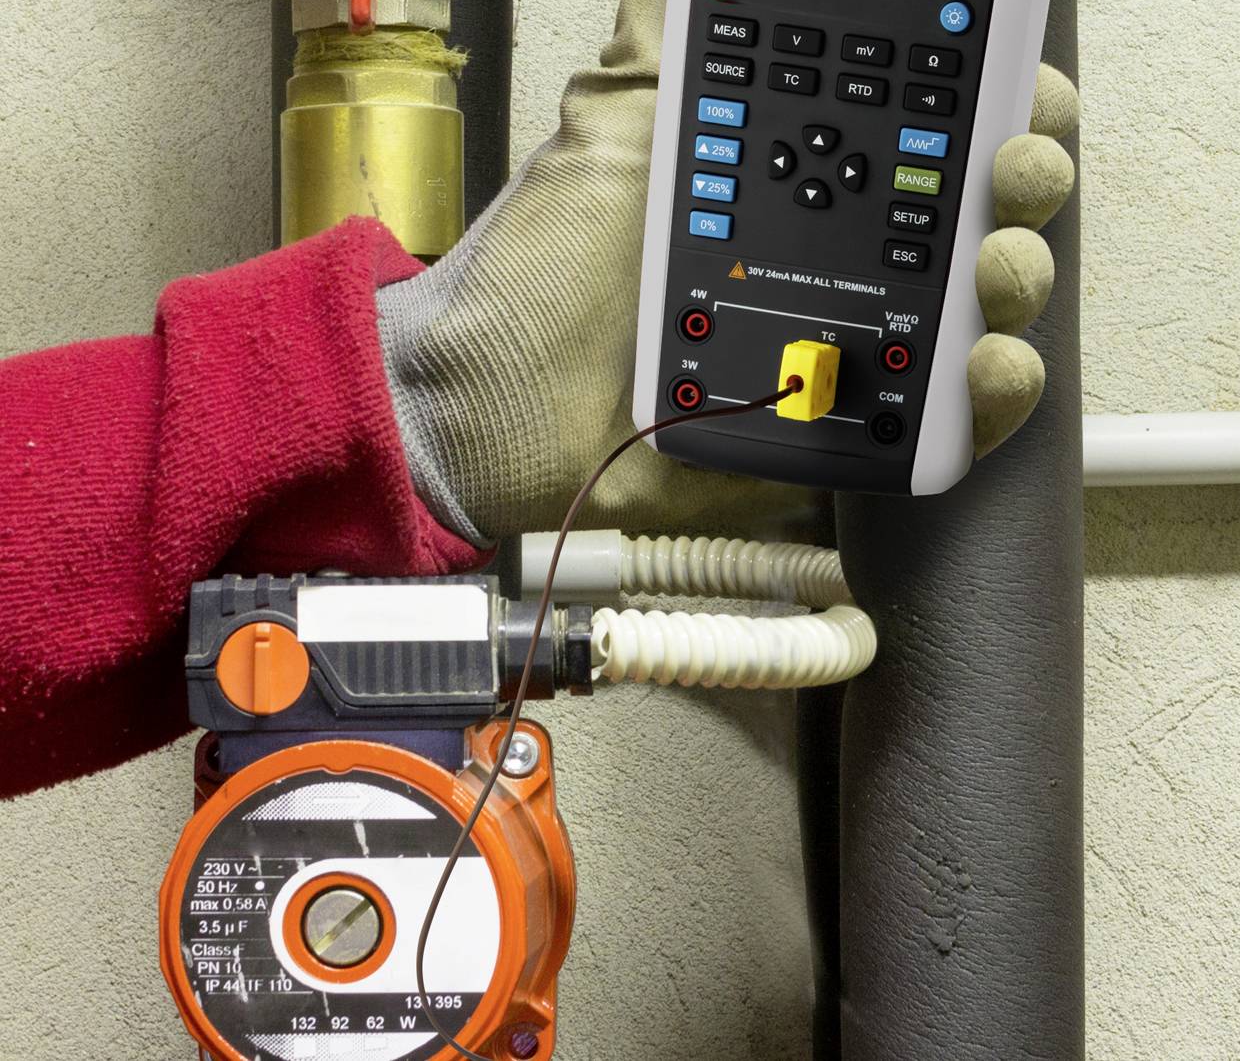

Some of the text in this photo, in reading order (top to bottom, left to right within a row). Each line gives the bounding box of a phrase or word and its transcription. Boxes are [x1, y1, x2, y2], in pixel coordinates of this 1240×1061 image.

[713, 23, 746, 39] MEAS
[792, 35, 802, 46] V
[856, 45, 876, 57] mV
[705, 62, 746, 78] SOURCE
[784, 73, 800, 86] TC
[848, 83, 873, 97] RTD
[706, 106, 735, 120] 100%
[712, 145, 735, 159] 25%
[896, 172, 937, 189] RANGE
[708, 182, 730, 196] 25%
[700, 219, 717, 232] 0%
[893, 211, 930, 227] SETUP
[892, 250, 918, 263] ESC
[748, 267, 886, 296] 30V 24mA MAX ALL TERMINALS
[690, 288, 708, 300] 4W
[890, 321, 912, 333] RTD
[821, 331, 836, 342] TC
[682, 359, 698, 371] 3W
[879, 391, 904, 404] COM
[204, 863, 230, 875] 230
[234, 863, 246, 875] V
[197, 881, 238, 893] 50 Hz
[190, 897, 266, 912] max 0,58 A
[199, 920, 221, 935] 3,5
[238, 920, 248, 933] F
[192, 943, 231, 957] Class
[197, 961, 242, 974] PN 10
[206, 979, 220, 992] IP
[270, 979, 293, 992] 110
[434, 995, 462, 1009] 395
[290, 1016, 416, 1030] 132 92 62 W
